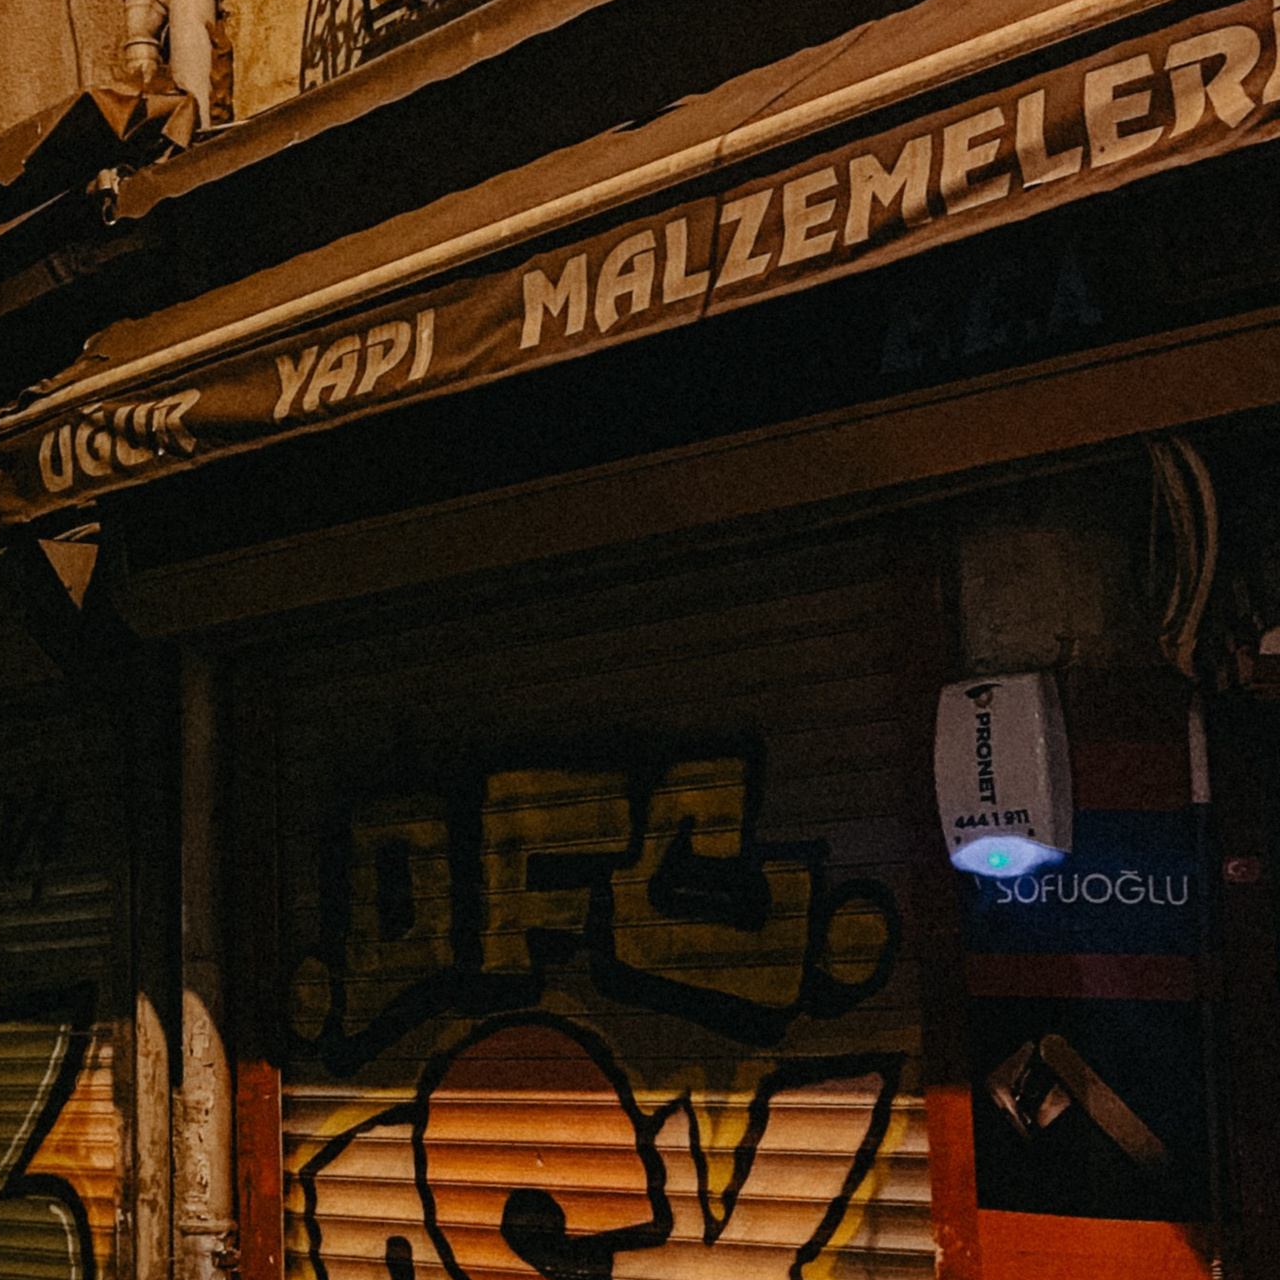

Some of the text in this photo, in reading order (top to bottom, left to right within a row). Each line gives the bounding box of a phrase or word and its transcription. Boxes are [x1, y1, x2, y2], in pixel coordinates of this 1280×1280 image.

[273, 308, 435, 424] YAPI
[975, 712, 997, 806] PRONET
[954, 812, 990, 829] 444
[996, 870, 1190, 906] SOFUOĞLU
